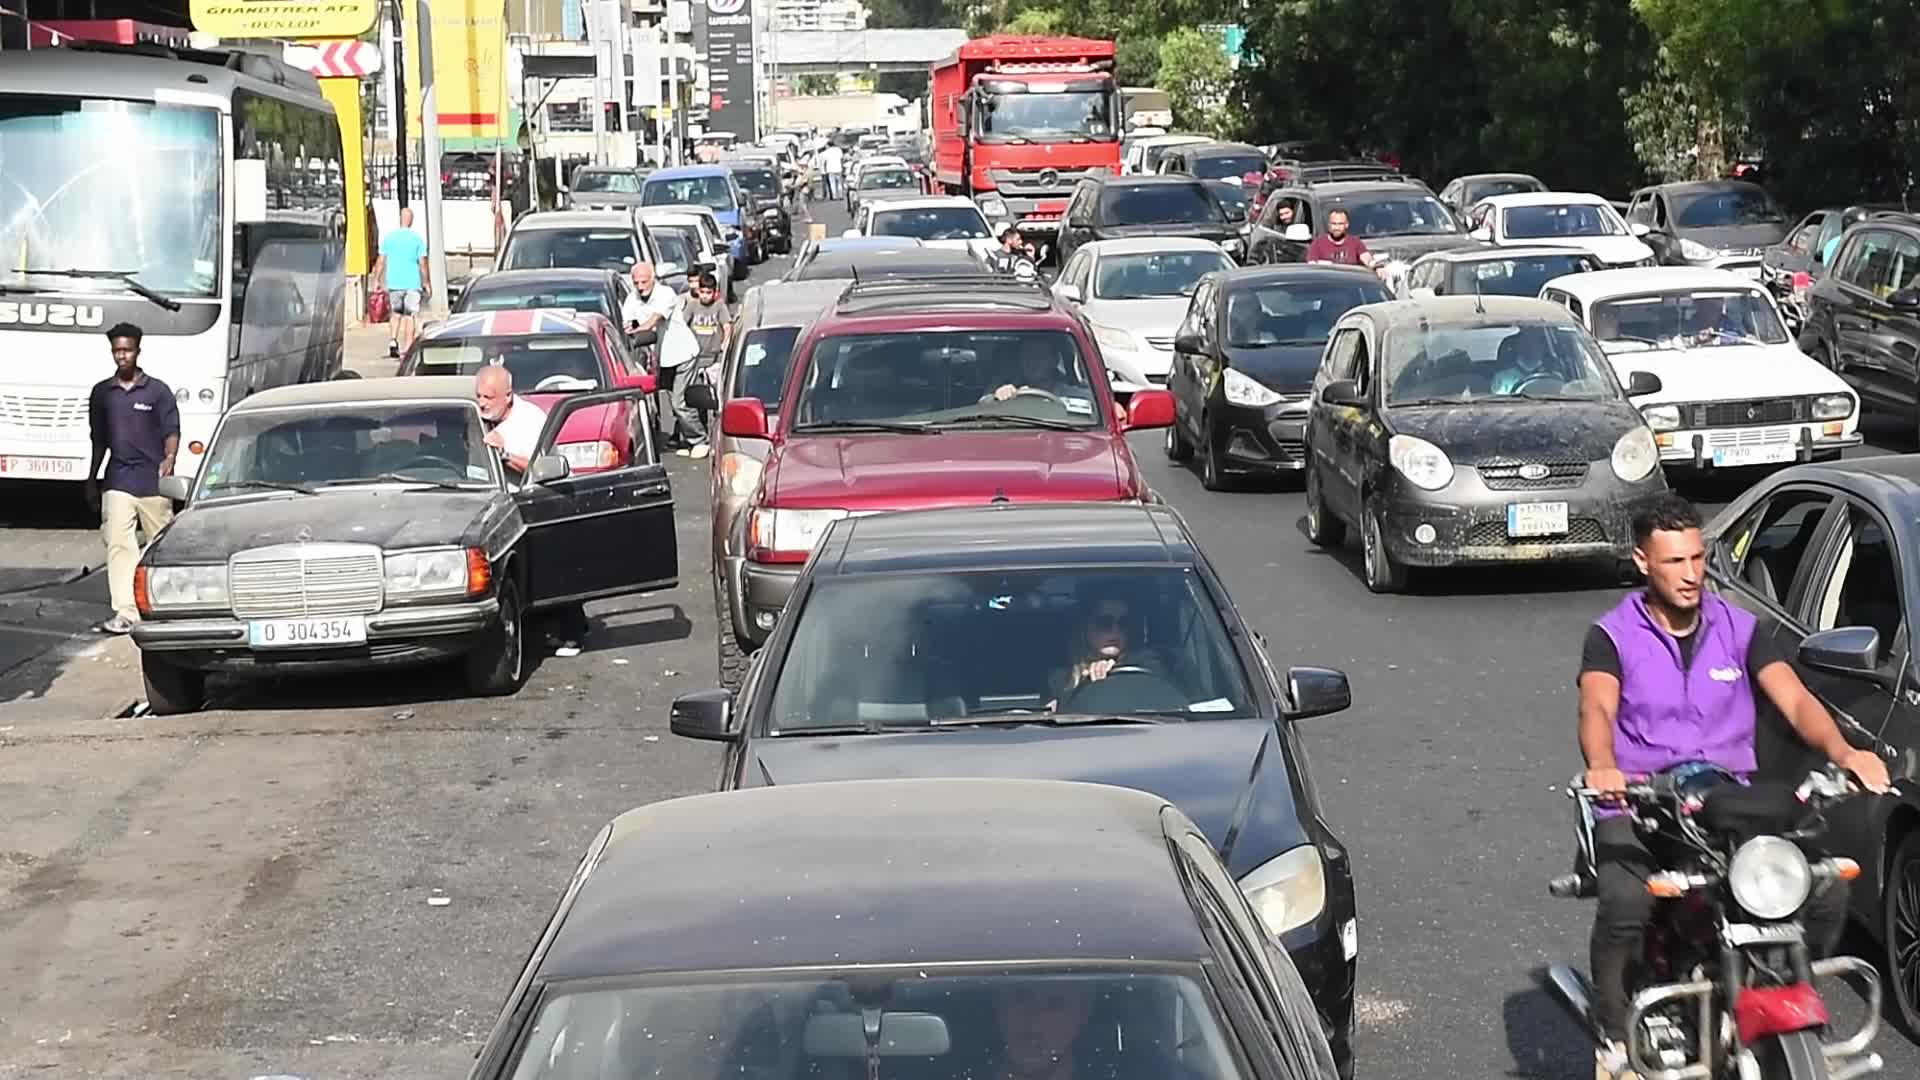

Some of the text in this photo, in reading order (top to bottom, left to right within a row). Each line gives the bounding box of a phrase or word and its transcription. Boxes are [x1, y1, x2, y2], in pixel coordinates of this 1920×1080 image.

[206, 5, 359, 15] GRANDTREK AT3
[250, 20, 320, 29] DUNLOP
[287, 620, 351, 640] 304354
